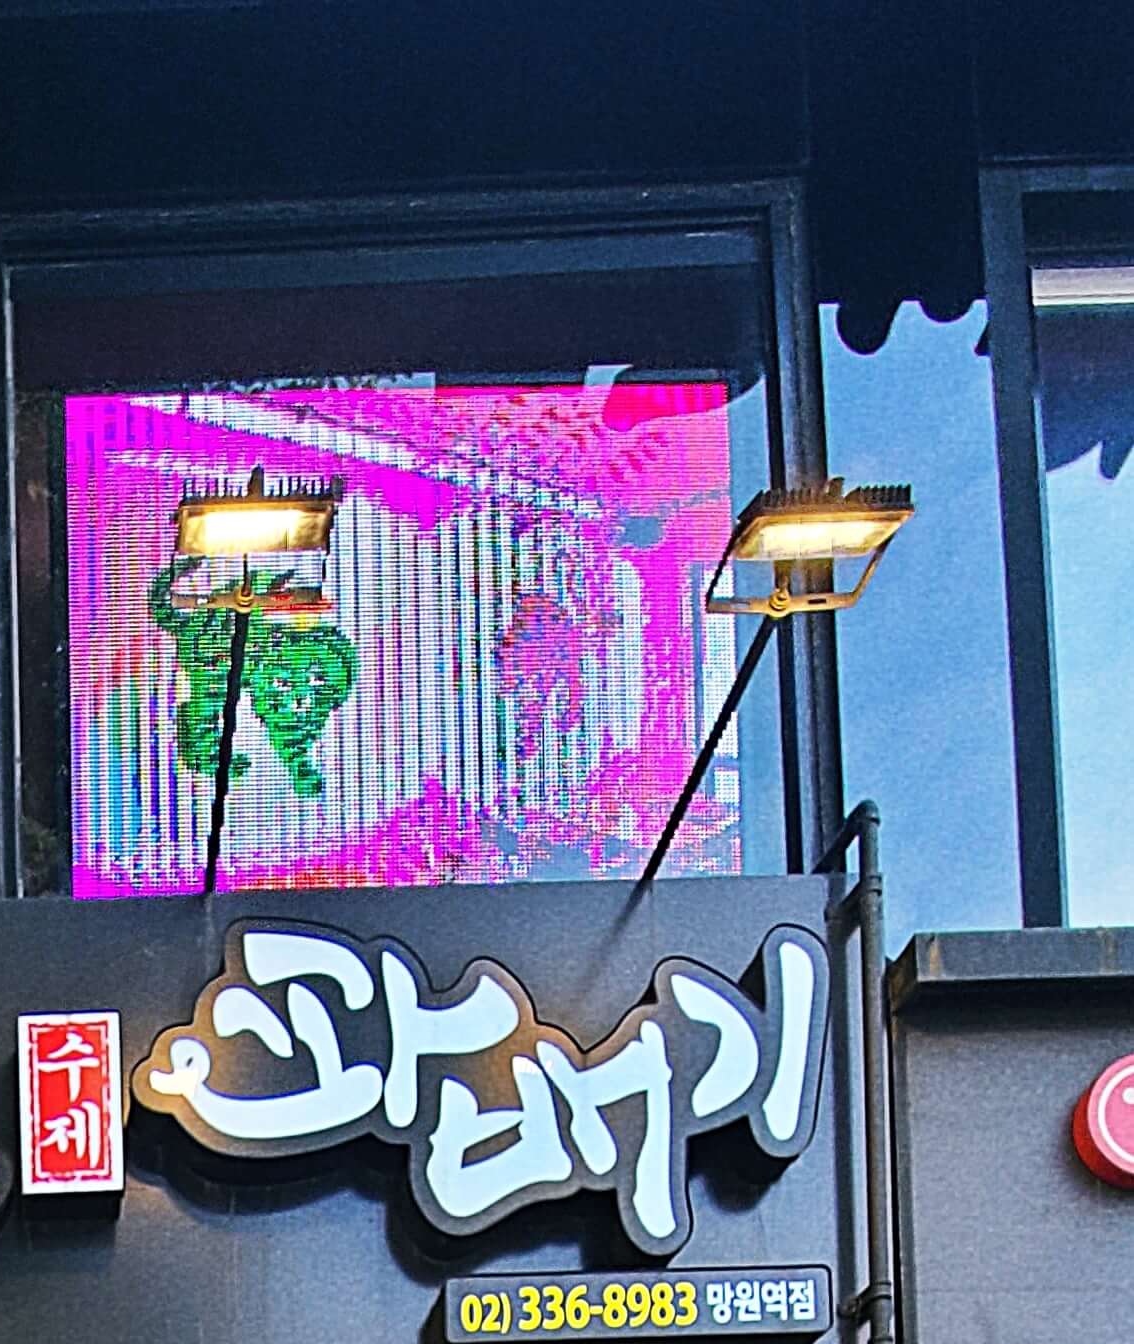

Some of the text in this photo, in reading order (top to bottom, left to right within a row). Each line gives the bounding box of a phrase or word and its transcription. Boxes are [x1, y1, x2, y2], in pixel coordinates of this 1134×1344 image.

[38, 1030, 104, 1172] 수제
[148, 929, 814, 1239] 꽈배기
[459, 1277, 818, 1335] 02) 336-8983 망원역점
